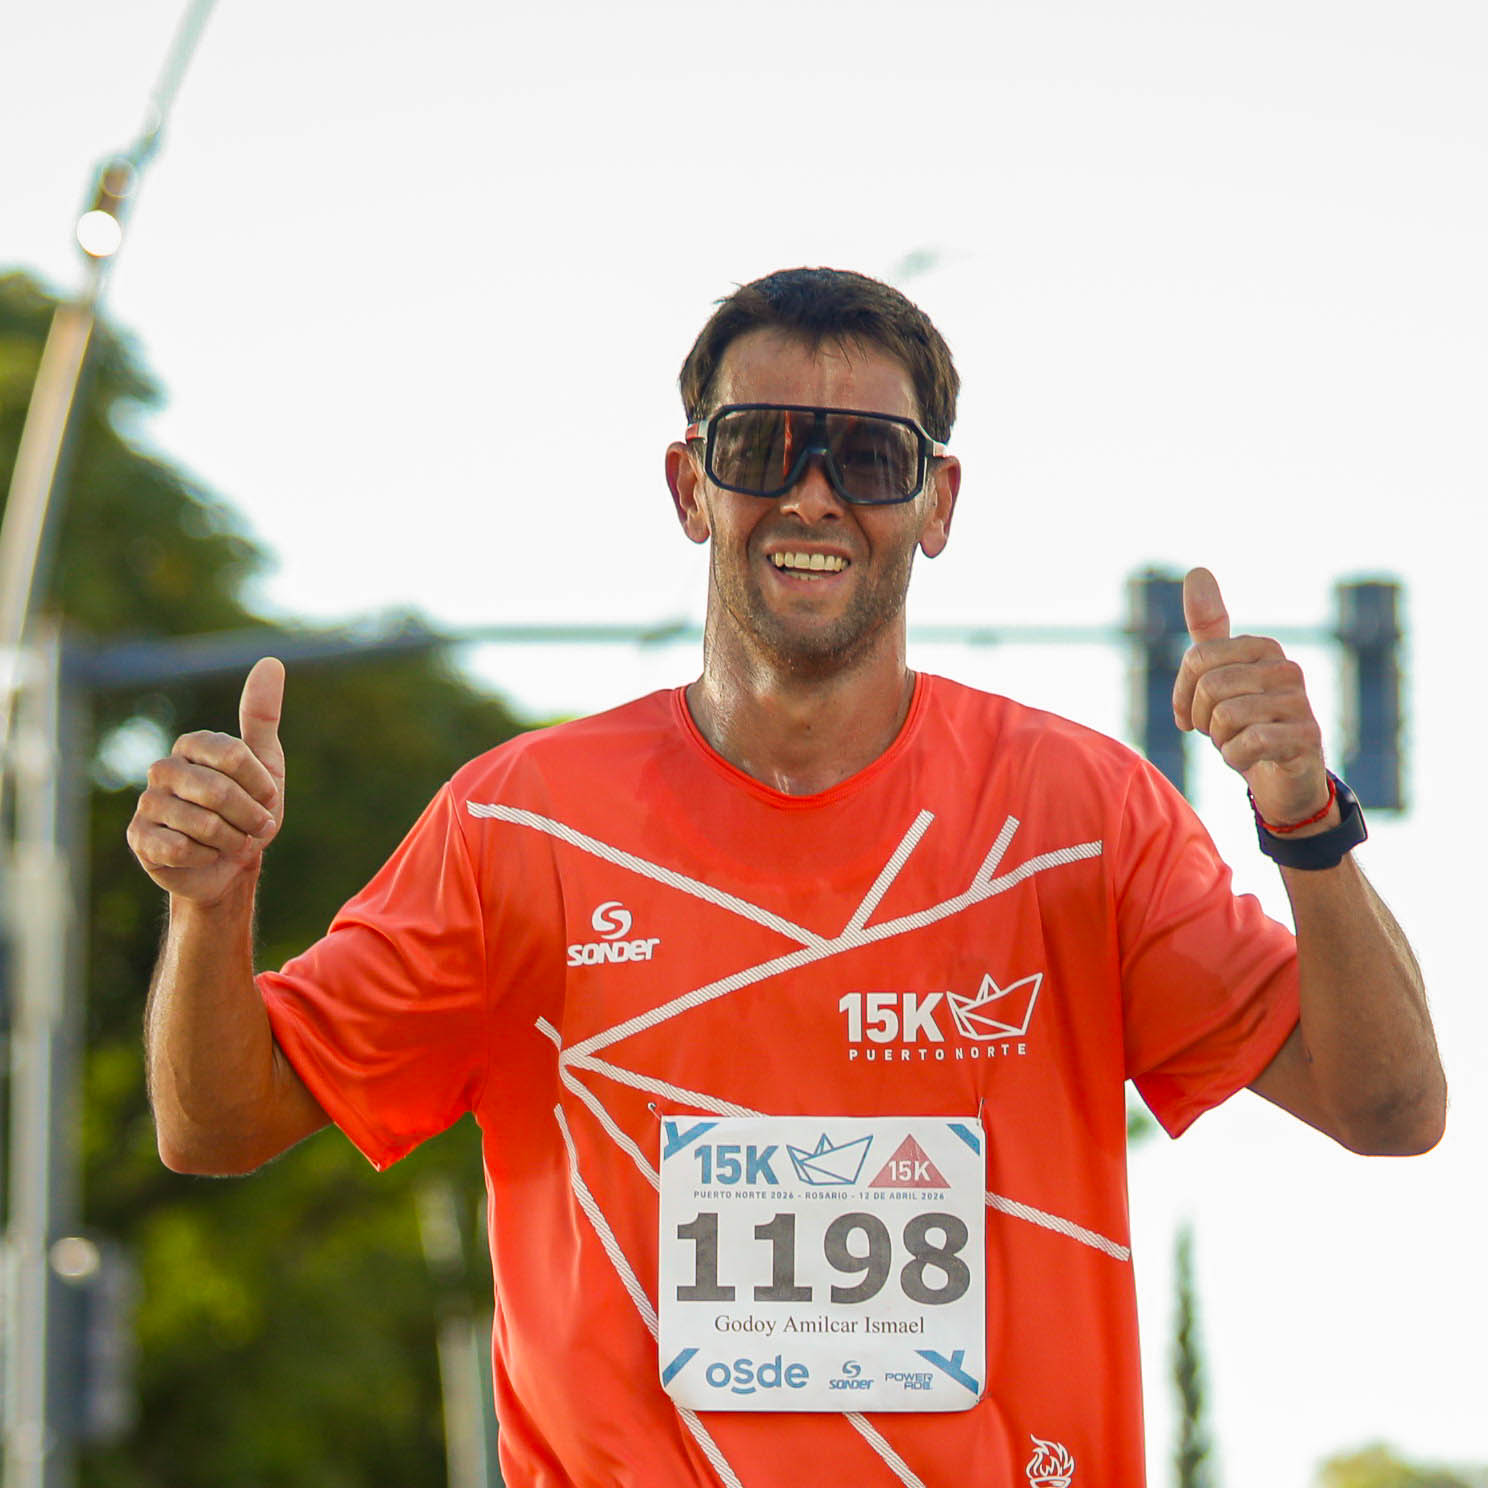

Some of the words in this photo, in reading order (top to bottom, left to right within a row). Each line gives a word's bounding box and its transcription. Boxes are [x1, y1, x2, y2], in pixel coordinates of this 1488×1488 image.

[839, 992, 945, 1043] 15K
[849, 1049, 945, 1061] PUERTO
[955, 1043, 1026, 1060] NORTE
[694, 1145, 779, 1185] 15K
[888, 1160, 931, 1181] 15K
[694, 1191, 732, 1199] PUERTO
[735, 1191, 767, 1199] NORTE
[771, 1191, 794, 1199] 2026
[805, 1191, 848, 1200] ROSARIO
[859, 1192, 870, 1200] 12
[873, 1192, 885, 1200] DE
[889, 1192, 918, 1200] ABRIL
[921, 1192, 945, 1200] 2026
[676, 1212, 971, 1305] 1198
[714, 1315, 776, 1337] Godoy
[783, 1315, 859, 1333] Amilcar
[864, 1316, 925, 1334] Ismael
[705, 1354, 810, 1390] osde
[885, 1372, 934, 1382] POWER
